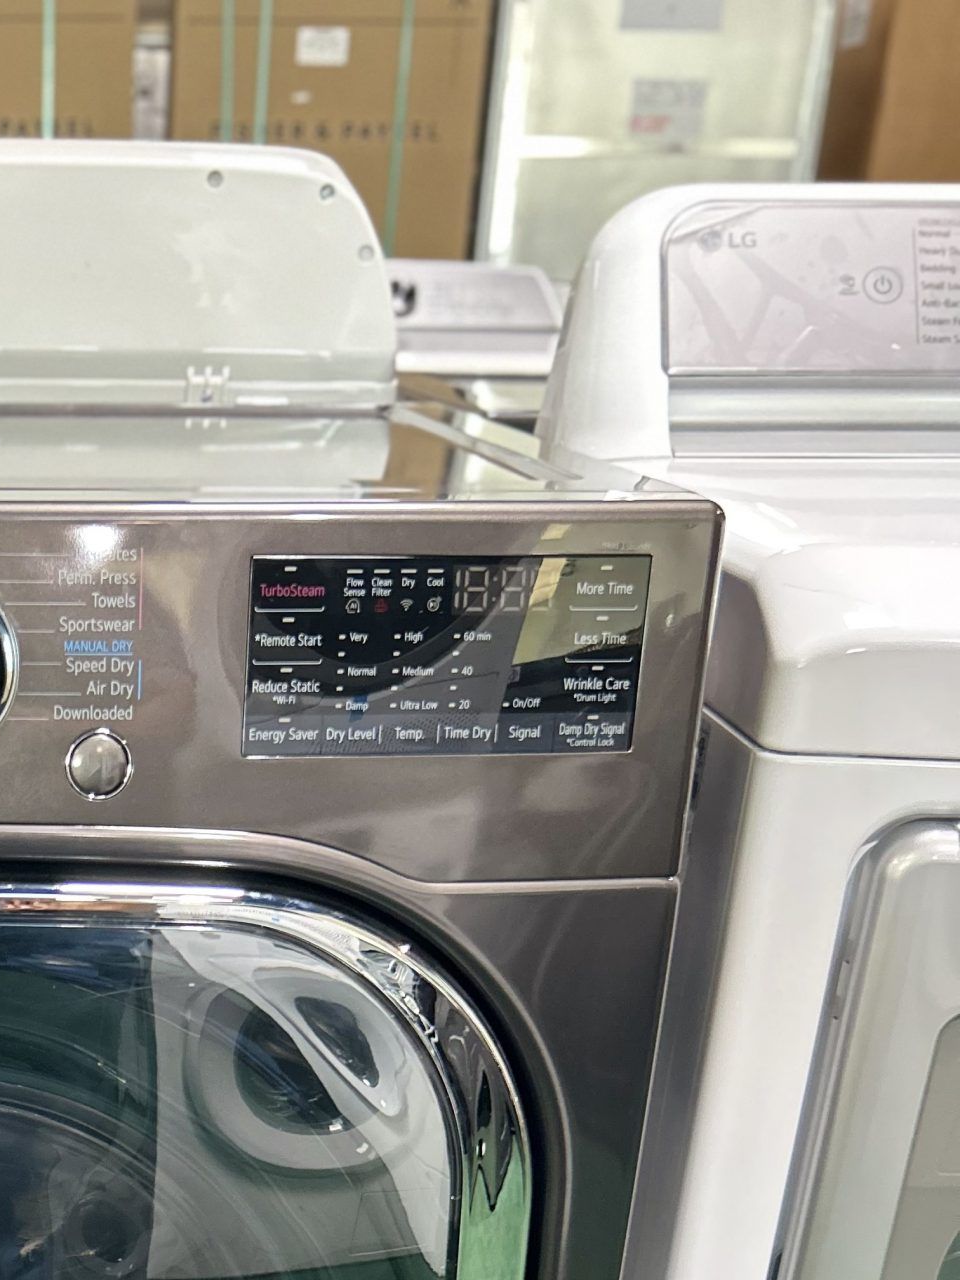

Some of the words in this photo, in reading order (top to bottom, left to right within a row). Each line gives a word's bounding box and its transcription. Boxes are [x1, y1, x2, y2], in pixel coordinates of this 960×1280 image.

[728, 231, 757, 249] LG
[58, 569, 96, 586] Perm.
[100, 569, 137, 586] Press
[346, 578, 364, 587] Flow
[371, 578, 392, 587] Clean
[402, 578, 415, 589] Dry
[427, 578, 444, 587] Cool
[260, 583, 325, 598] TurboSteam
[344, 588, 365, 597] Sense
[371, 588, 391, 597] Filter
[576, 582, 605, 595] More
[608, 582, 633, 595] Time
[91, 592, 136, 609] Towels
[59, 616, 135, 635] Sportswear
[298, 632, 322, 647] Start
[350, 632, 368, 644] Very
[404, 632, 423, 644] High
[464, 631, 474, 642] 60
[477, 631, 491, 642] min
[574, 632, 598, 645] Less
[601, 632, 627, 645] Time
[64, 640, 108, 652] MANUAL
[112, 640, 133, 652] DRY
[66, 657, 107, 675] Speed
[111, 657, 134, 676] Dry
[347, 666, 377, 676] Normal
[402, 666, 434, 676] Medium
[461, 665, 473, 676] 40
[252, 679, 288, 693] Reduce
[290, 679, 320, 693] Static
[564, 677, 603, 690] Wrinkle
[605, 677, 630, 690] Care
[86, 681, 107, 696] Air
[111, 681, 134, 699] Dry
[458, 699, 470, 709] 20
[512, 698, 541, 709] On/Off
[597, 693, 617, 704] Light
[345, 701, 369, 712] Damp
[400, 700, 419, 710] Ultra
[422, 700, 438, 710] Low
[53, 705, 133, 721] Downloaded
[249, 727, 286, 744] Energy
[289, 727, 318, 740] Saver
[326, 728, 345, 744] Dry
[348, 727, 376, 740] Level
[394, 727, 425, 742] Temp.
[444, 726, 470, 739] Time
[472, 726, 491, 741] Dry
[509, 725, 541, 741] Signal
[559, 723, 582, 738] Damp
[584, 723, 599, 737] Dry
[600, 723, 626, 738] Signal
[598, 738, 615, 747] Lock
